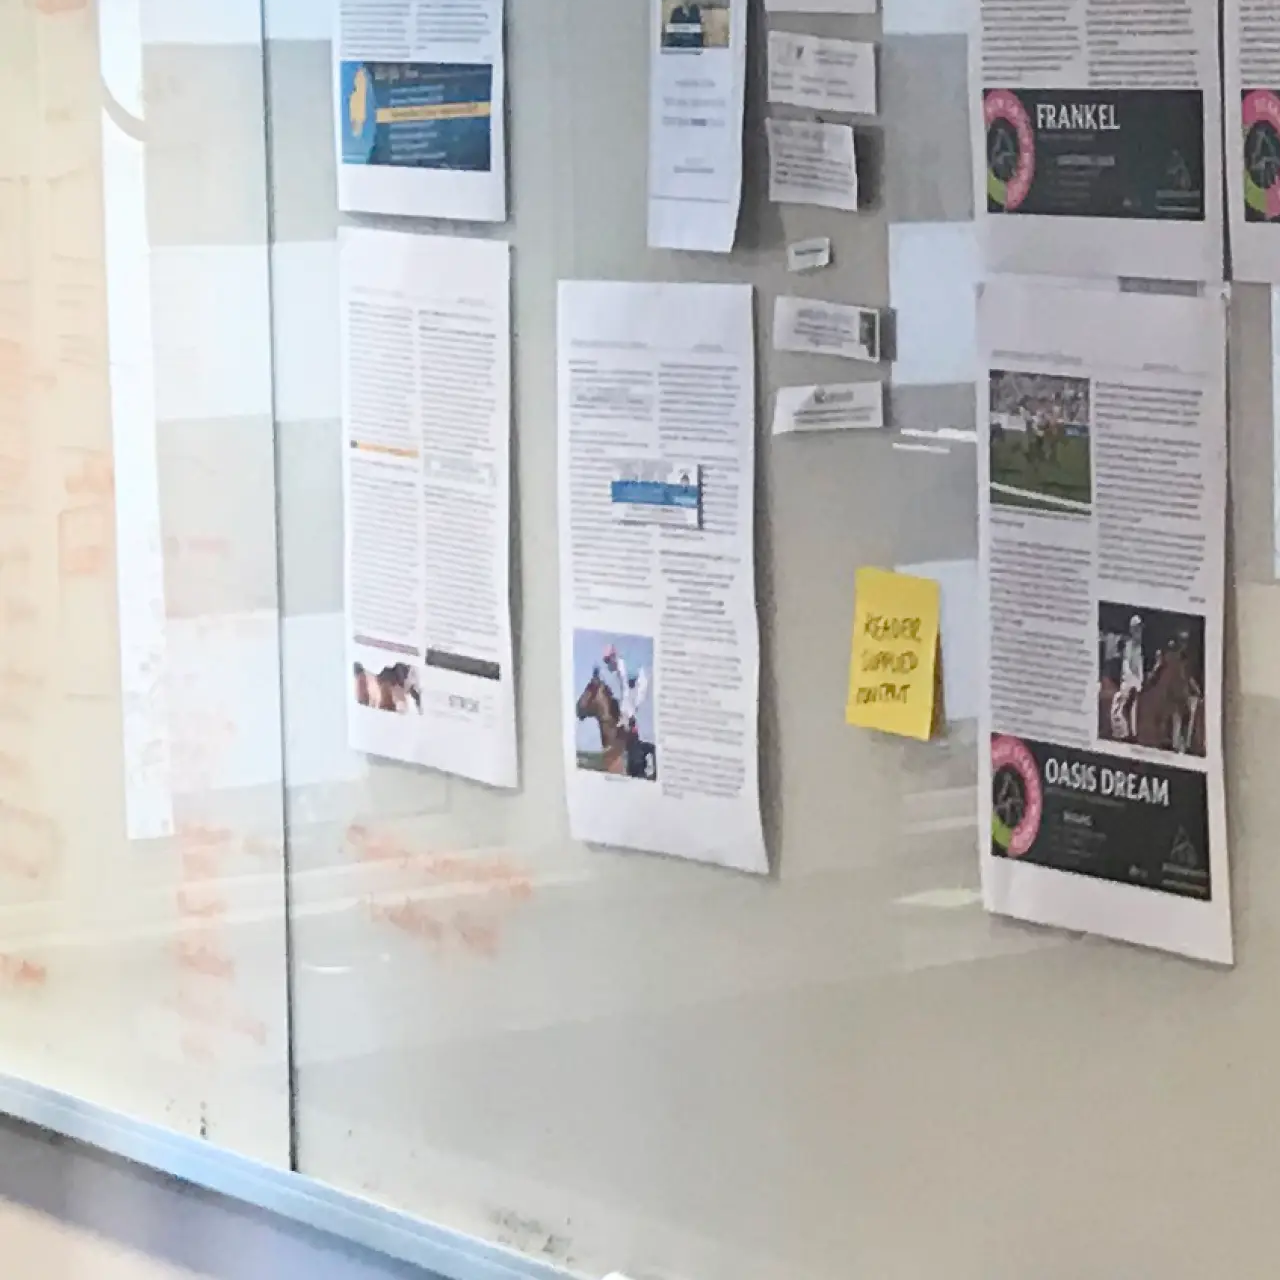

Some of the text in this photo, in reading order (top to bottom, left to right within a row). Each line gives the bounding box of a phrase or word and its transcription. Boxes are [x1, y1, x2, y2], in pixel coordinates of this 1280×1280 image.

[1036, 102, 1121, 131] FRANKEL
[1045, 758, 1170, 807] OASIS DREAM
